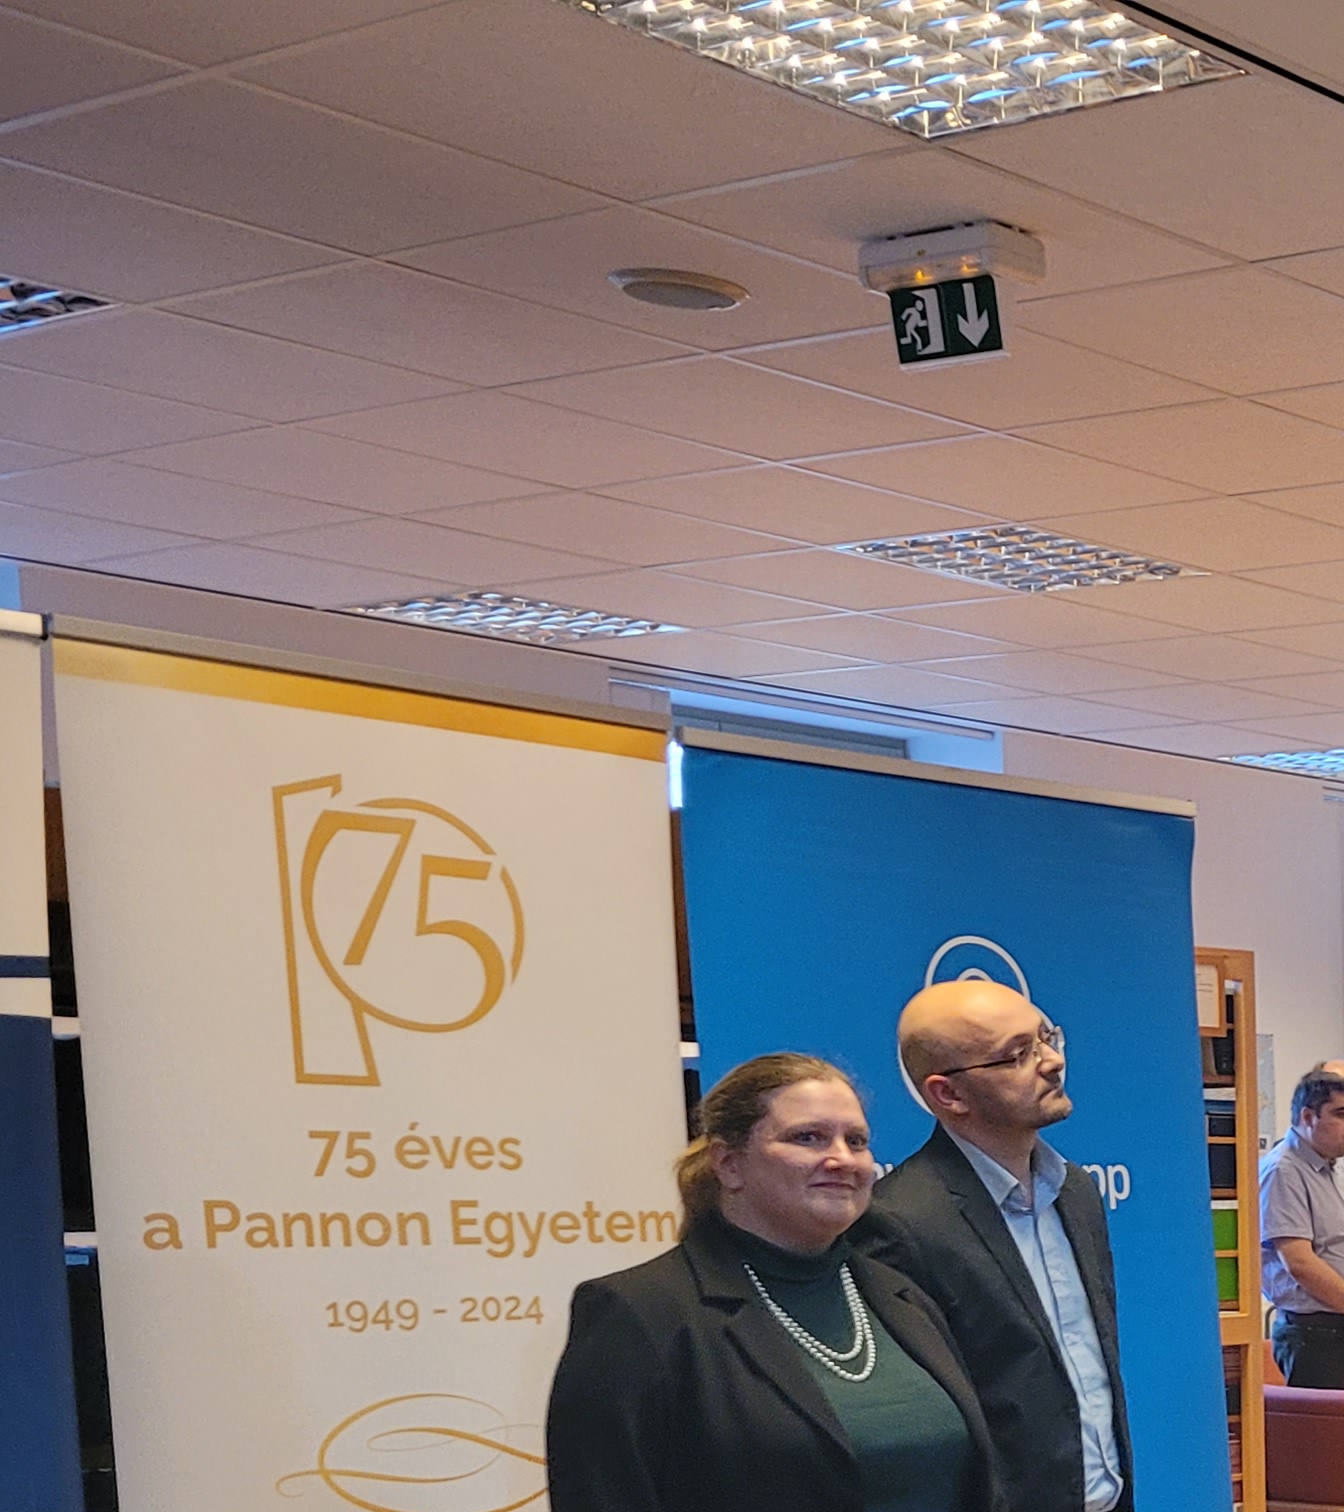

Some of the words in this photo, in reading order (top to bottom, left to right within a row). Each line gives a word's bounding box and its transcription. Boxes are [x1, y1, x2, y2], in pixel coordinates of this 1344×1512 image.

[309, 1129, 376, 1178] 75
[395, 1122, 524, 1171] éves
[143, 1213, 182, 1249] a
[204, 1199, 430, 1248] Pannon
[450, 1199, 679, 1259] Egyetem
[328, 1299, 418, 1331] 1949
[460, 1295, 544, 1325] 2024
